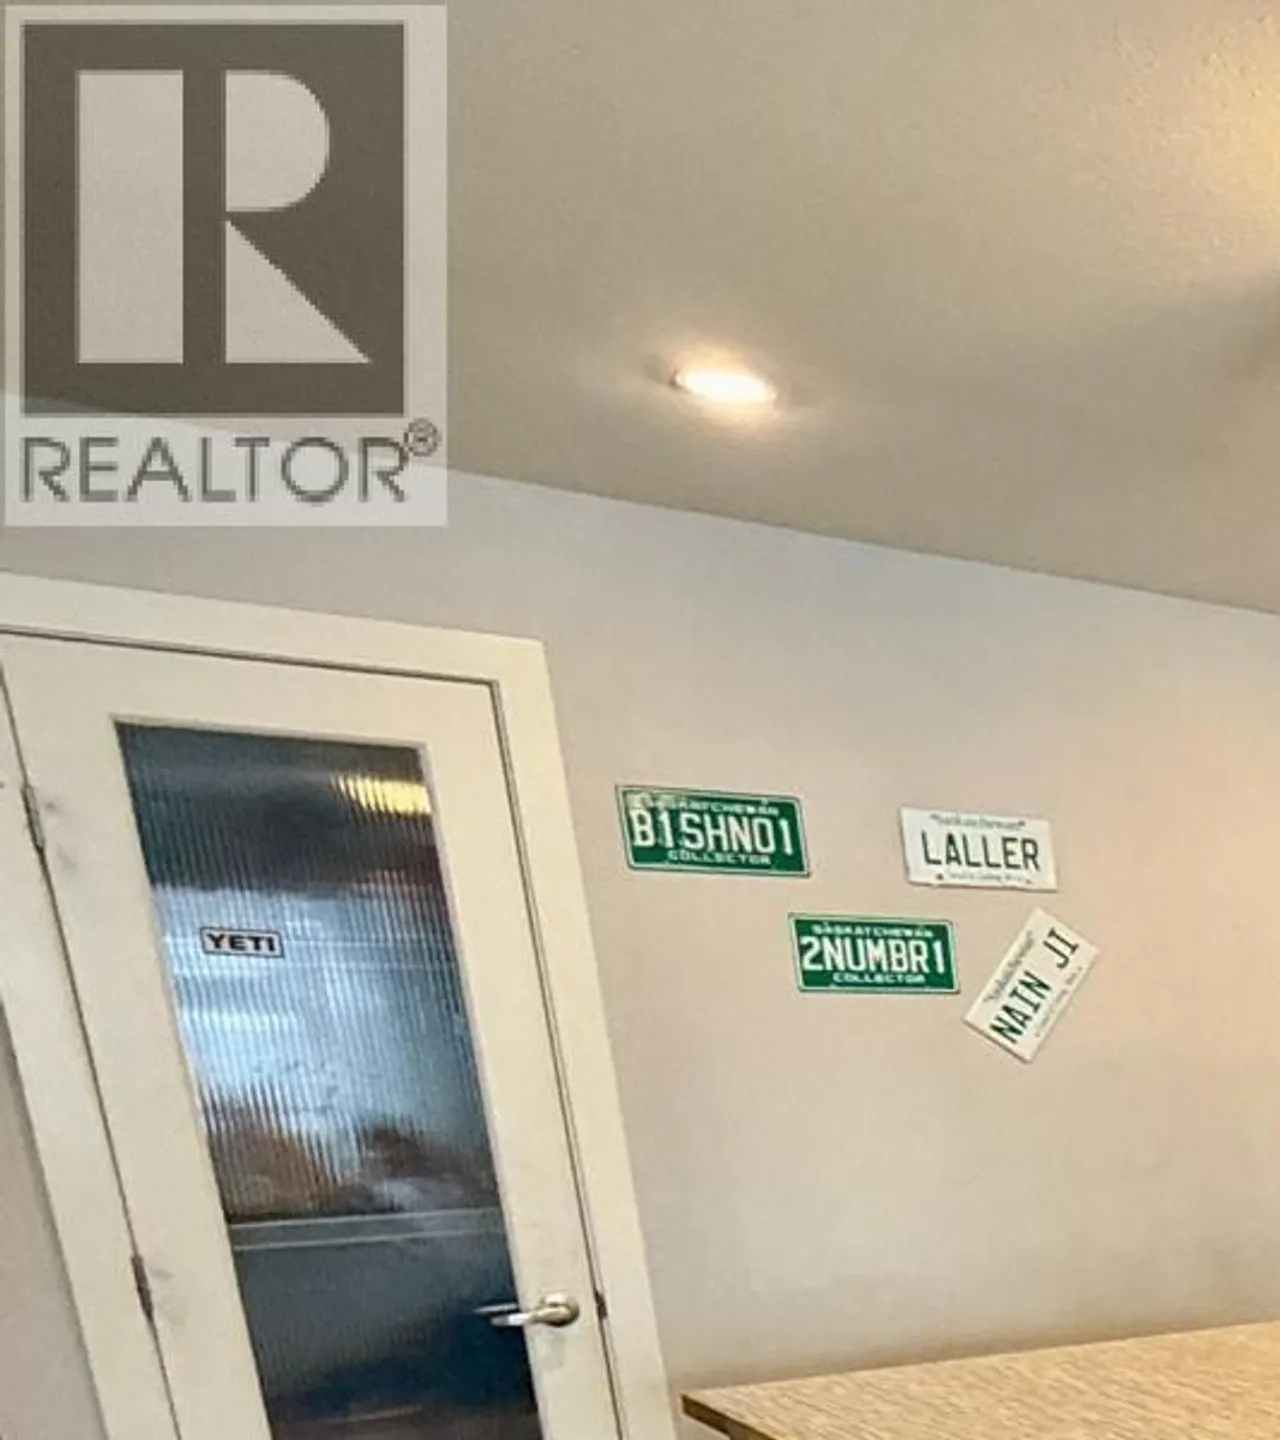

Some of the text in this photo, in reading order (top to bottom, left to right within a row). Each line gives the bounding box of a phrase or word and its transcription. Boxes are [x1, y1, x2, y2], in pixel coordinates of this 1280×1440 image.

[667, 850, 771, 865] COLLECTOR
[921, 830, 1040, 872] LALLER
[206, 932, 275, 952] YETI
[800, 935, 946, 974] 2NUMBR1
[832, 972, 926, 984] COLLECTOR
[989, 970, 1052, 1044] NAIN
[1042, 927, 1079, 969] JI
